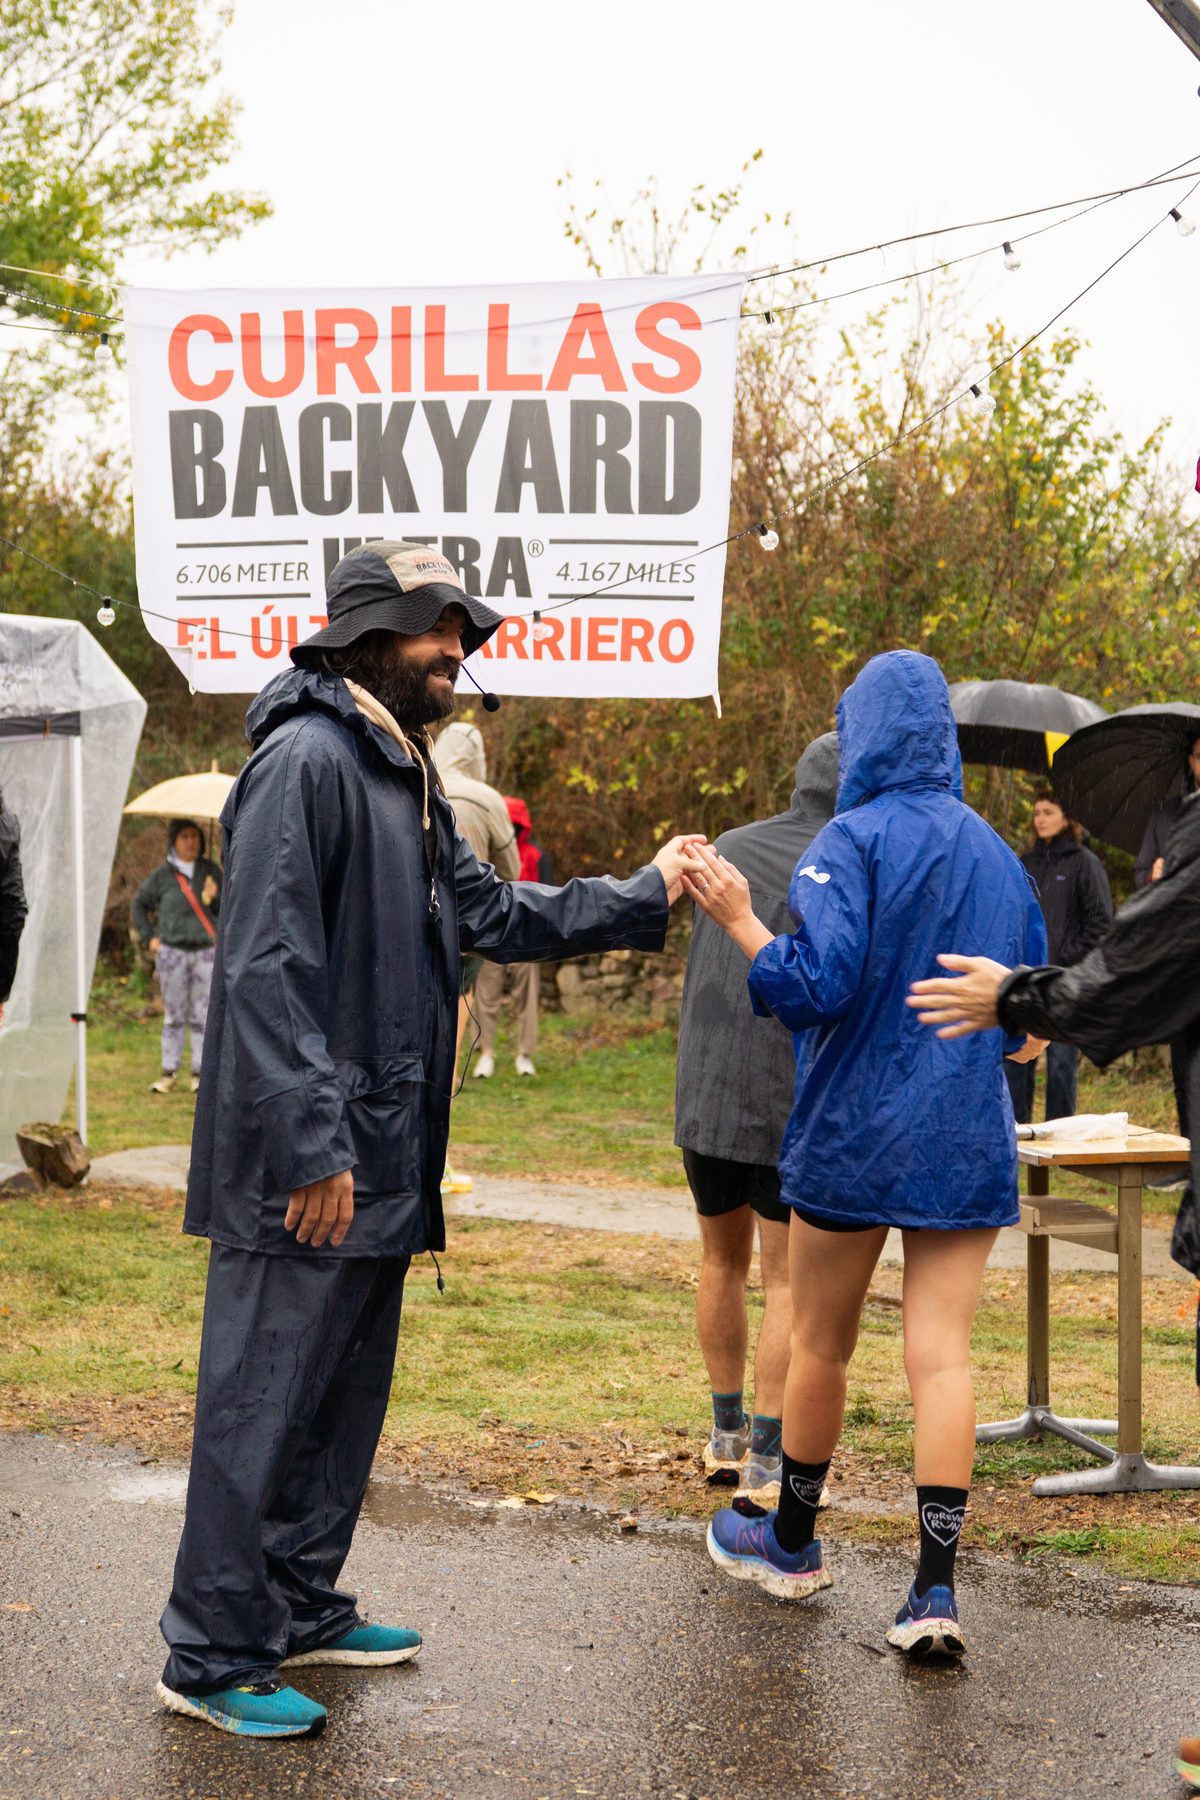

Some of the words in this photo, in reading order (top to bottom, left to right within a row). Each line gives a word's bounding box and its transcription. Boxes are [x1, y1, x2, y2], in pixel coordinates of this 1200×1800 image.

[168, 302, 703, 401] CURILLAS
[169, 399, 702, 520] BACKYARD
[176, 564, 232, 584] 6.706
[237, 562, 309, 582] METER
[556, 562, 621, 584] 4.167
[626, 562, 697, 584] MILES
[177, 617, 237, 660] EL
[931, 1520, 961, 1532] RUN
